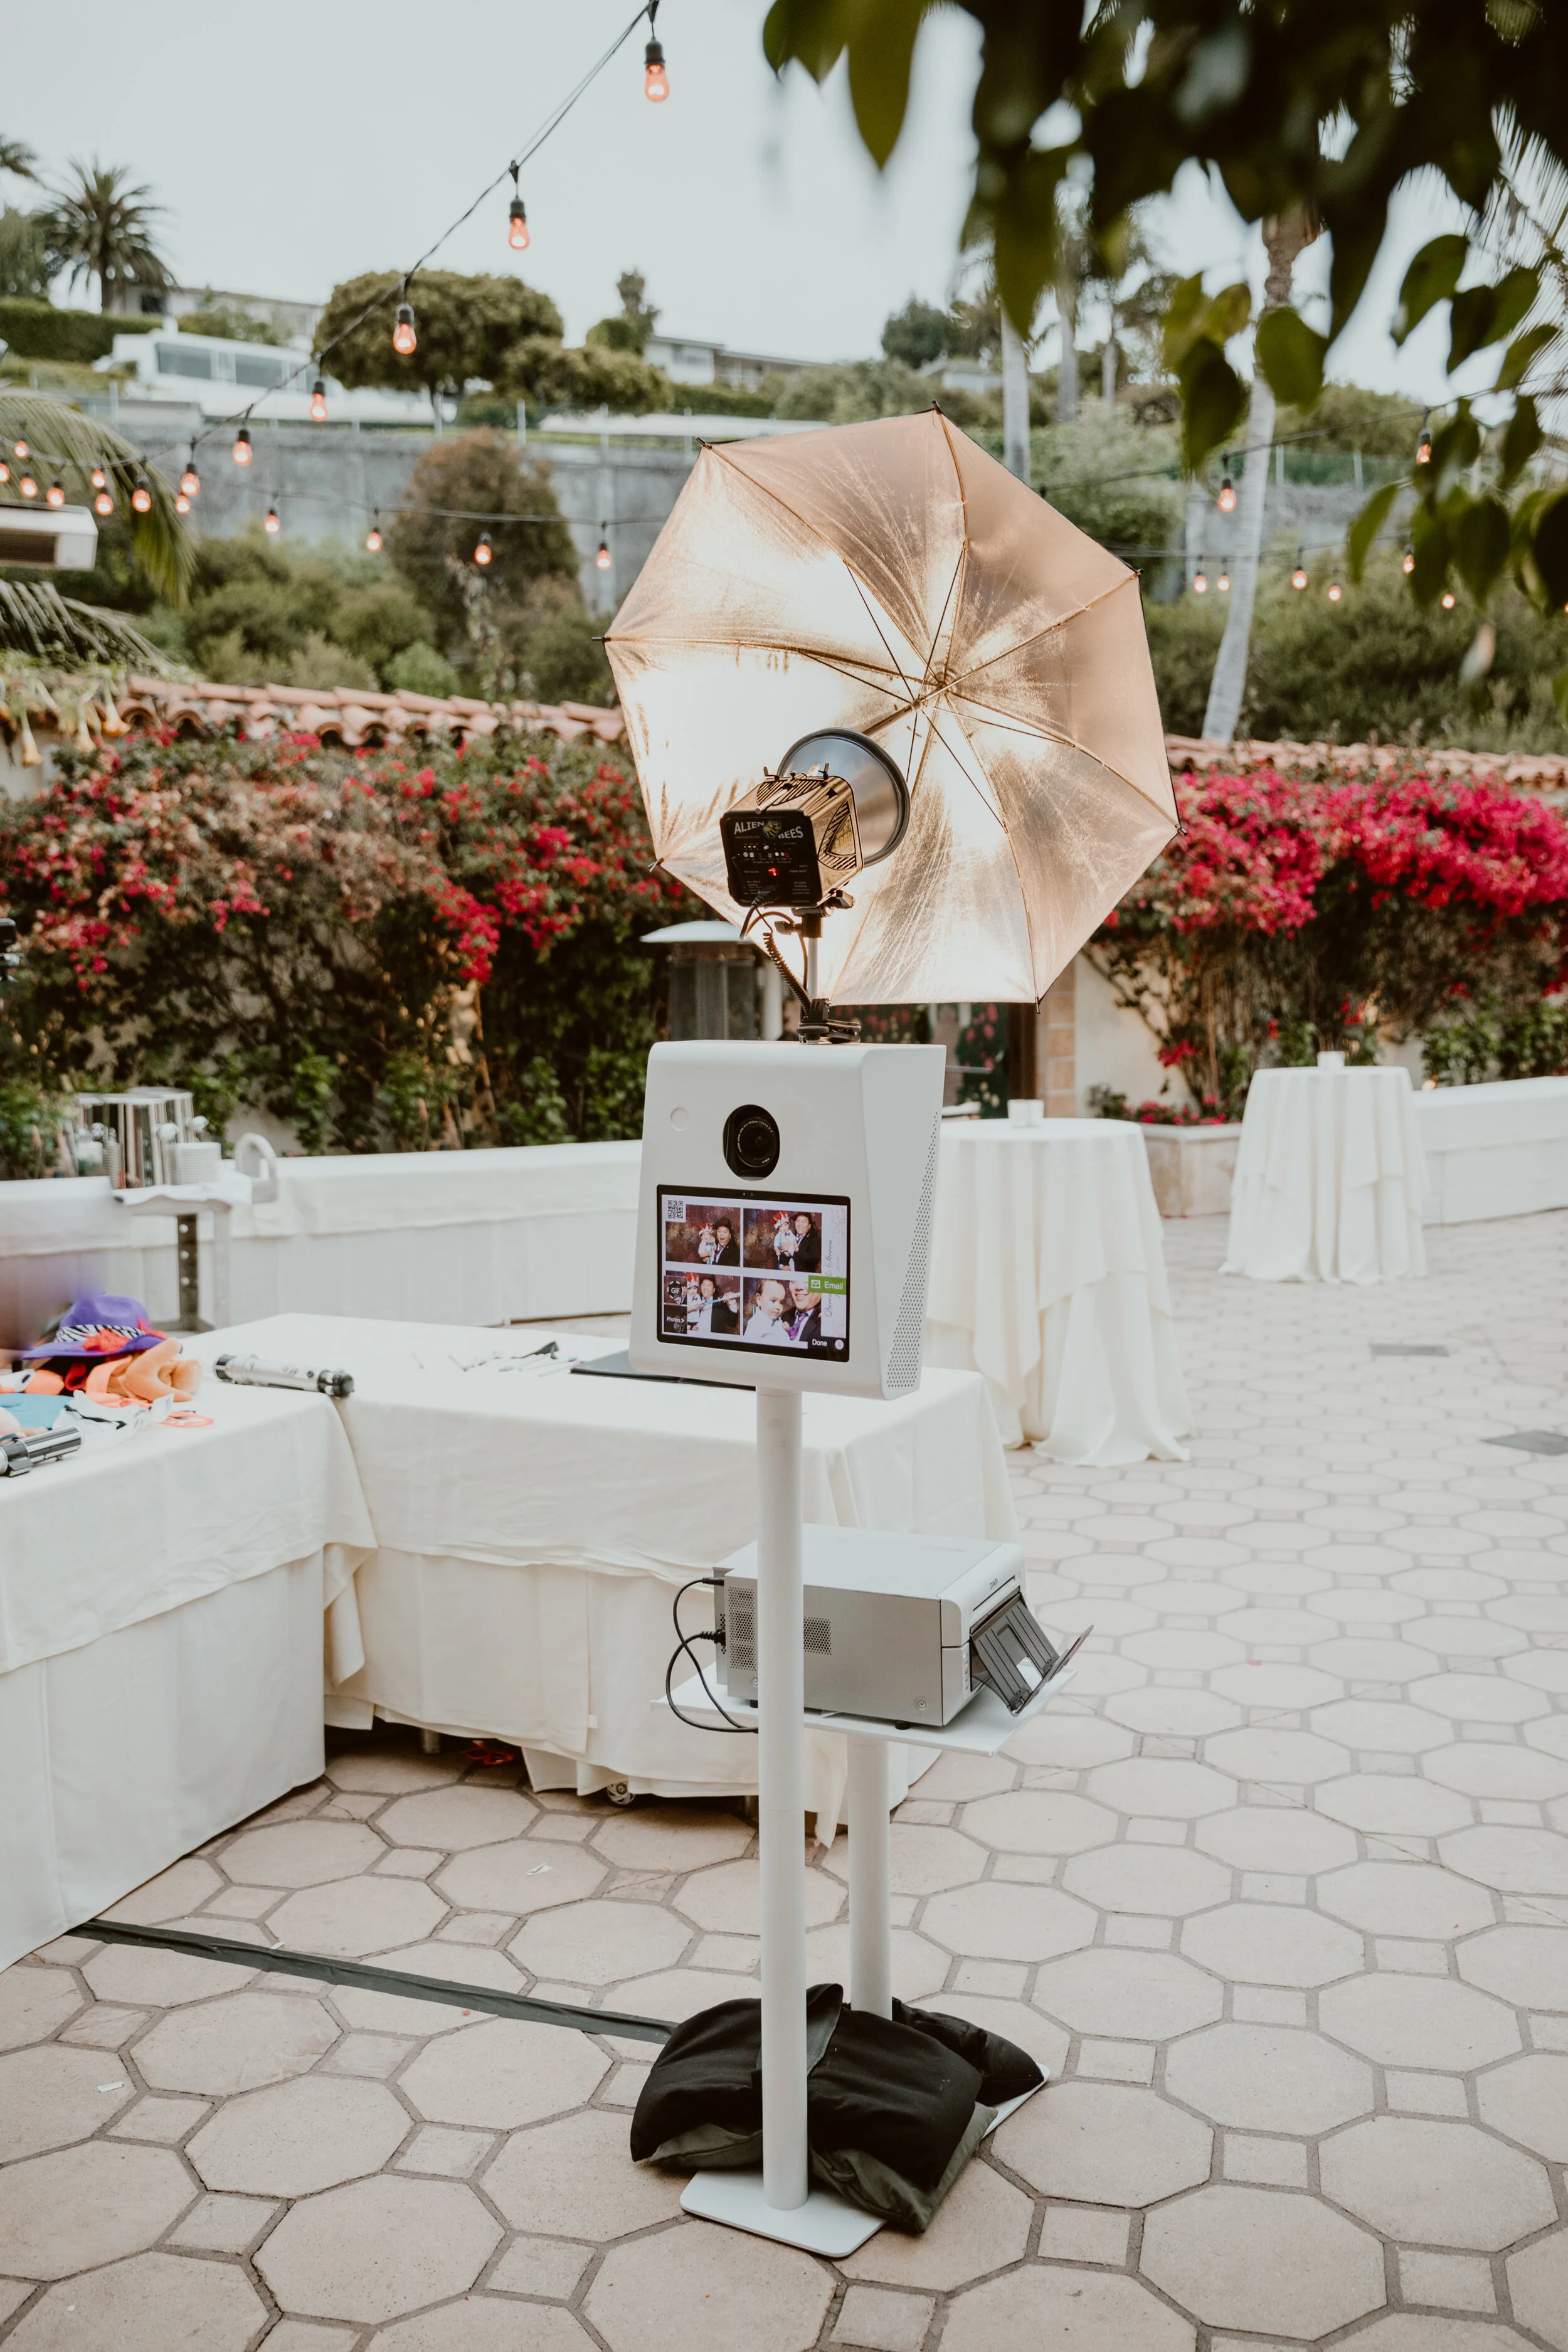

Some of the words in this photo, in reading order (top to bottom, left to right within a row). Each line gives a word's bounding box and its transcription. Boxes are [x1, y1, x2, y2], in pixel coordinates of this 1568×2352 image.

[734, 822, 765, 835] ALIEN
[778, 826, 803, 839] BEES
[824, 1281, 844, 1290] Email
[990, 1578, 998, 1589] DNP
